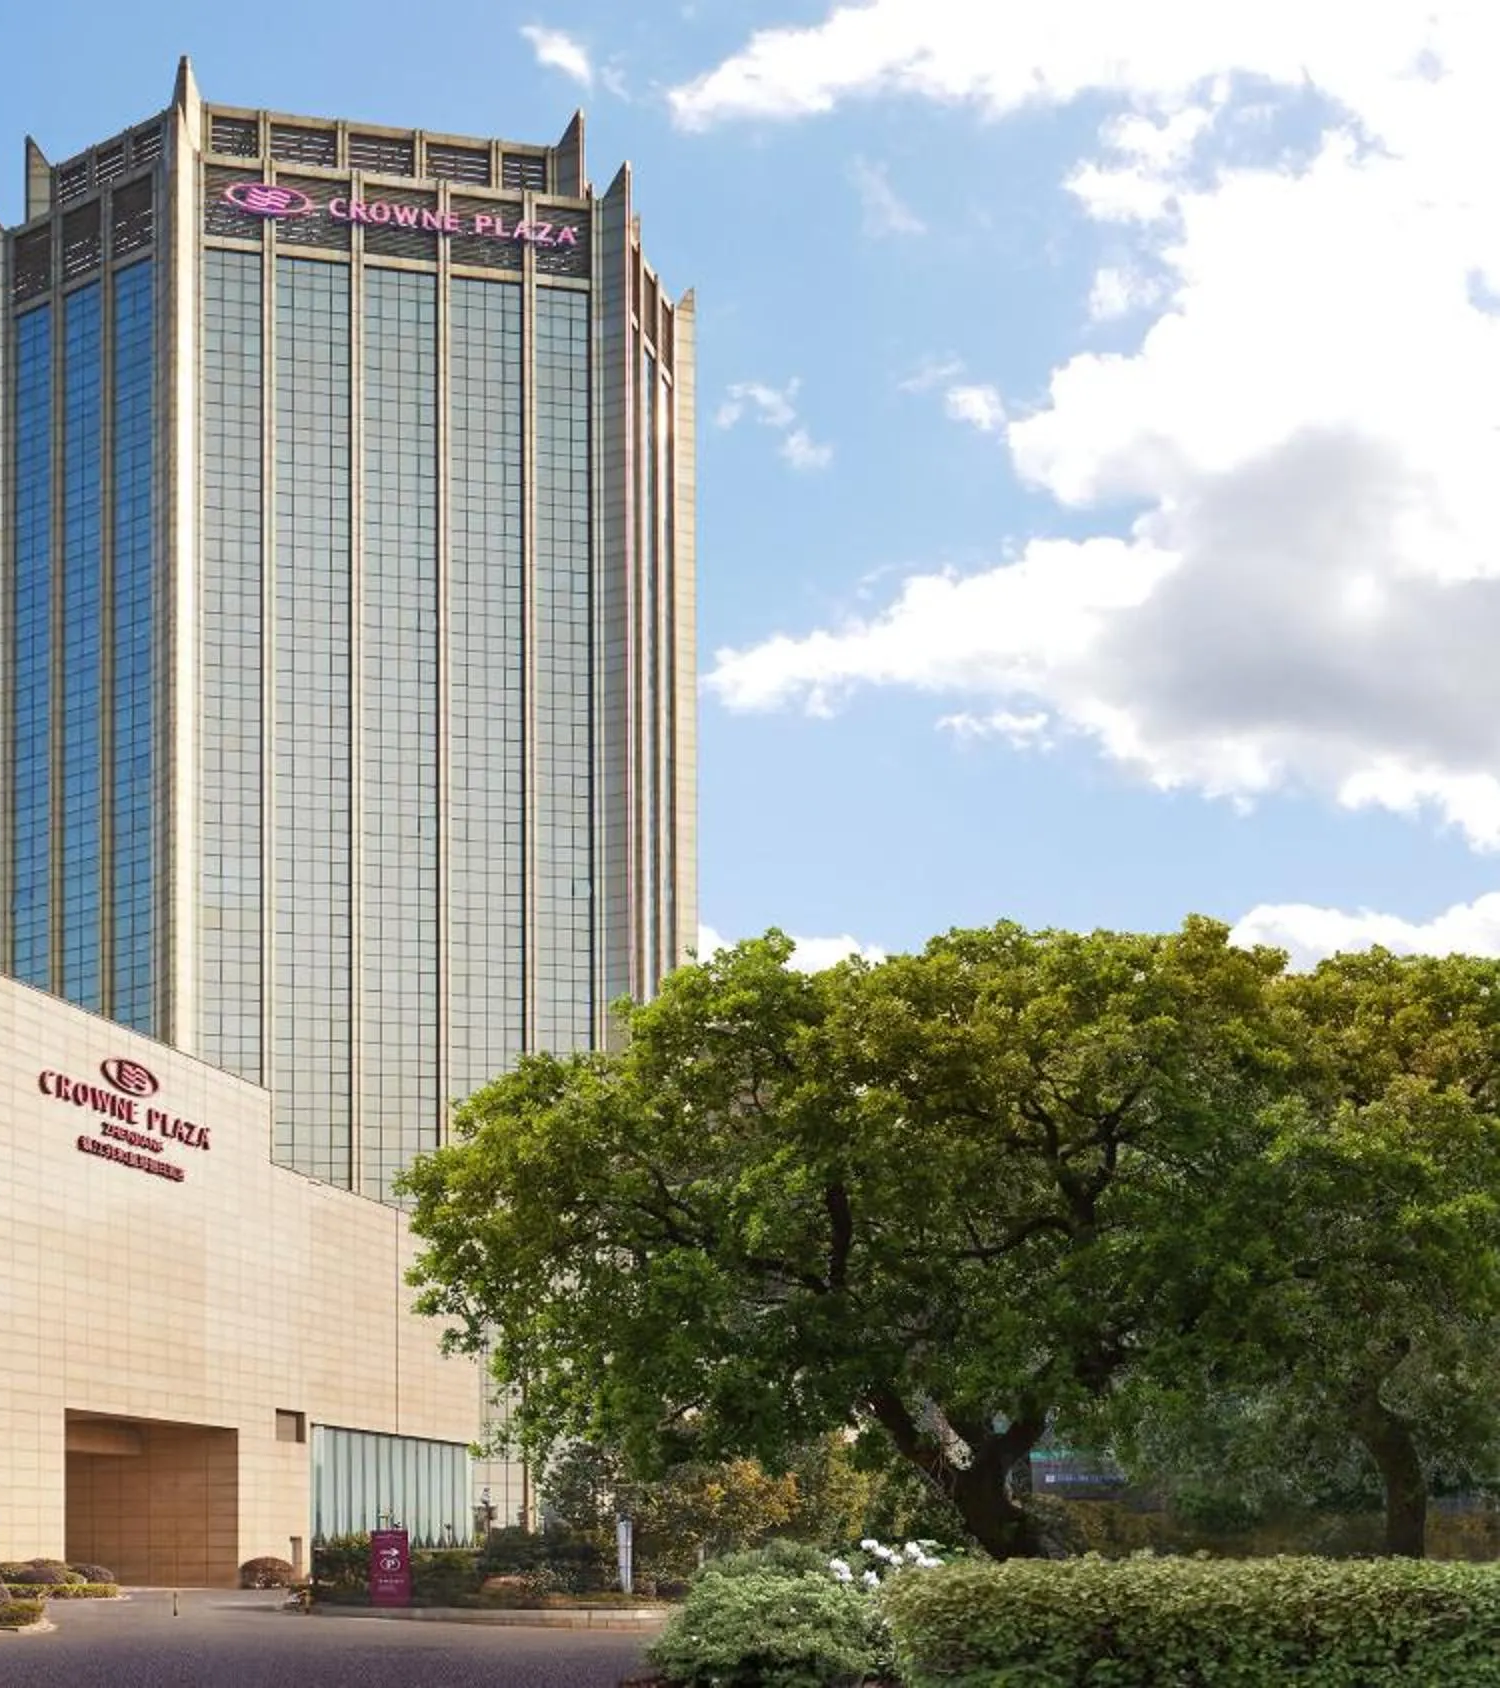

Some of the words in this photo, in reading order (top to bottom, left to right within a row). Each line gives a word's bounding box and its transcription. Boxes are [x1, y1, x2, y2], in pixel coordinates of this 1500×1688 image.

[329, 197, 460, 232] CROWNE
[474, 213, 577, 245] PLAZA
[38, 1070, 140, 1125] CROWNE
[146, 1108, 211, 1151] PLAZA
